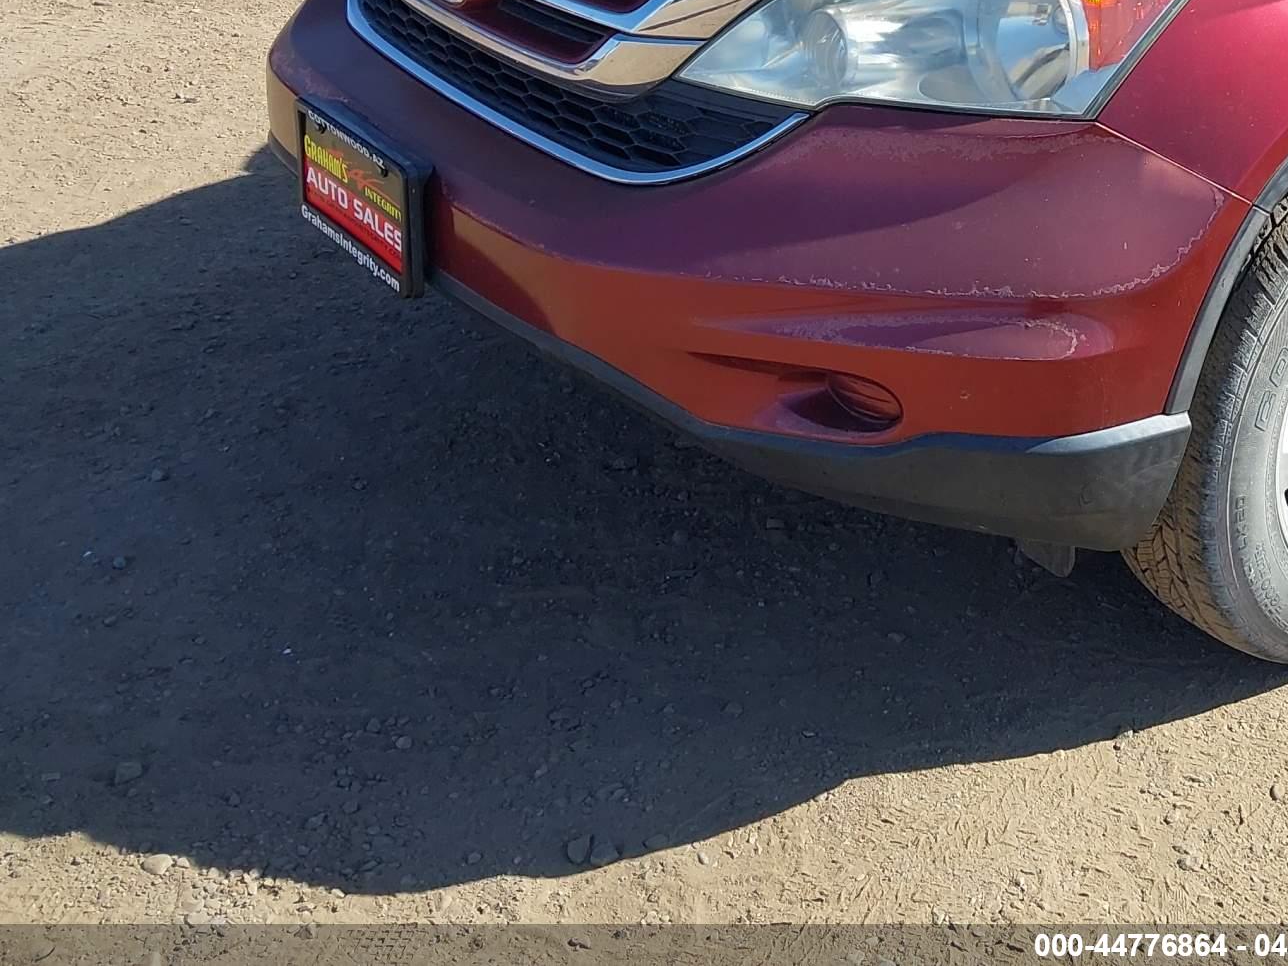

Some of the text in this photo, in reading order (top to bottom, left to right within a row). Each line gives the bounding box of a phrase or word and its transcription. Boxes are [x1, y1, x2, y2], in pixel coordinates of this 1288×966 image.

[301, 203, 400, 293] GrahamsIntegrity.com
[306, 166, 349, 210] AUTO
[353, 197, 402, 254] SALES
